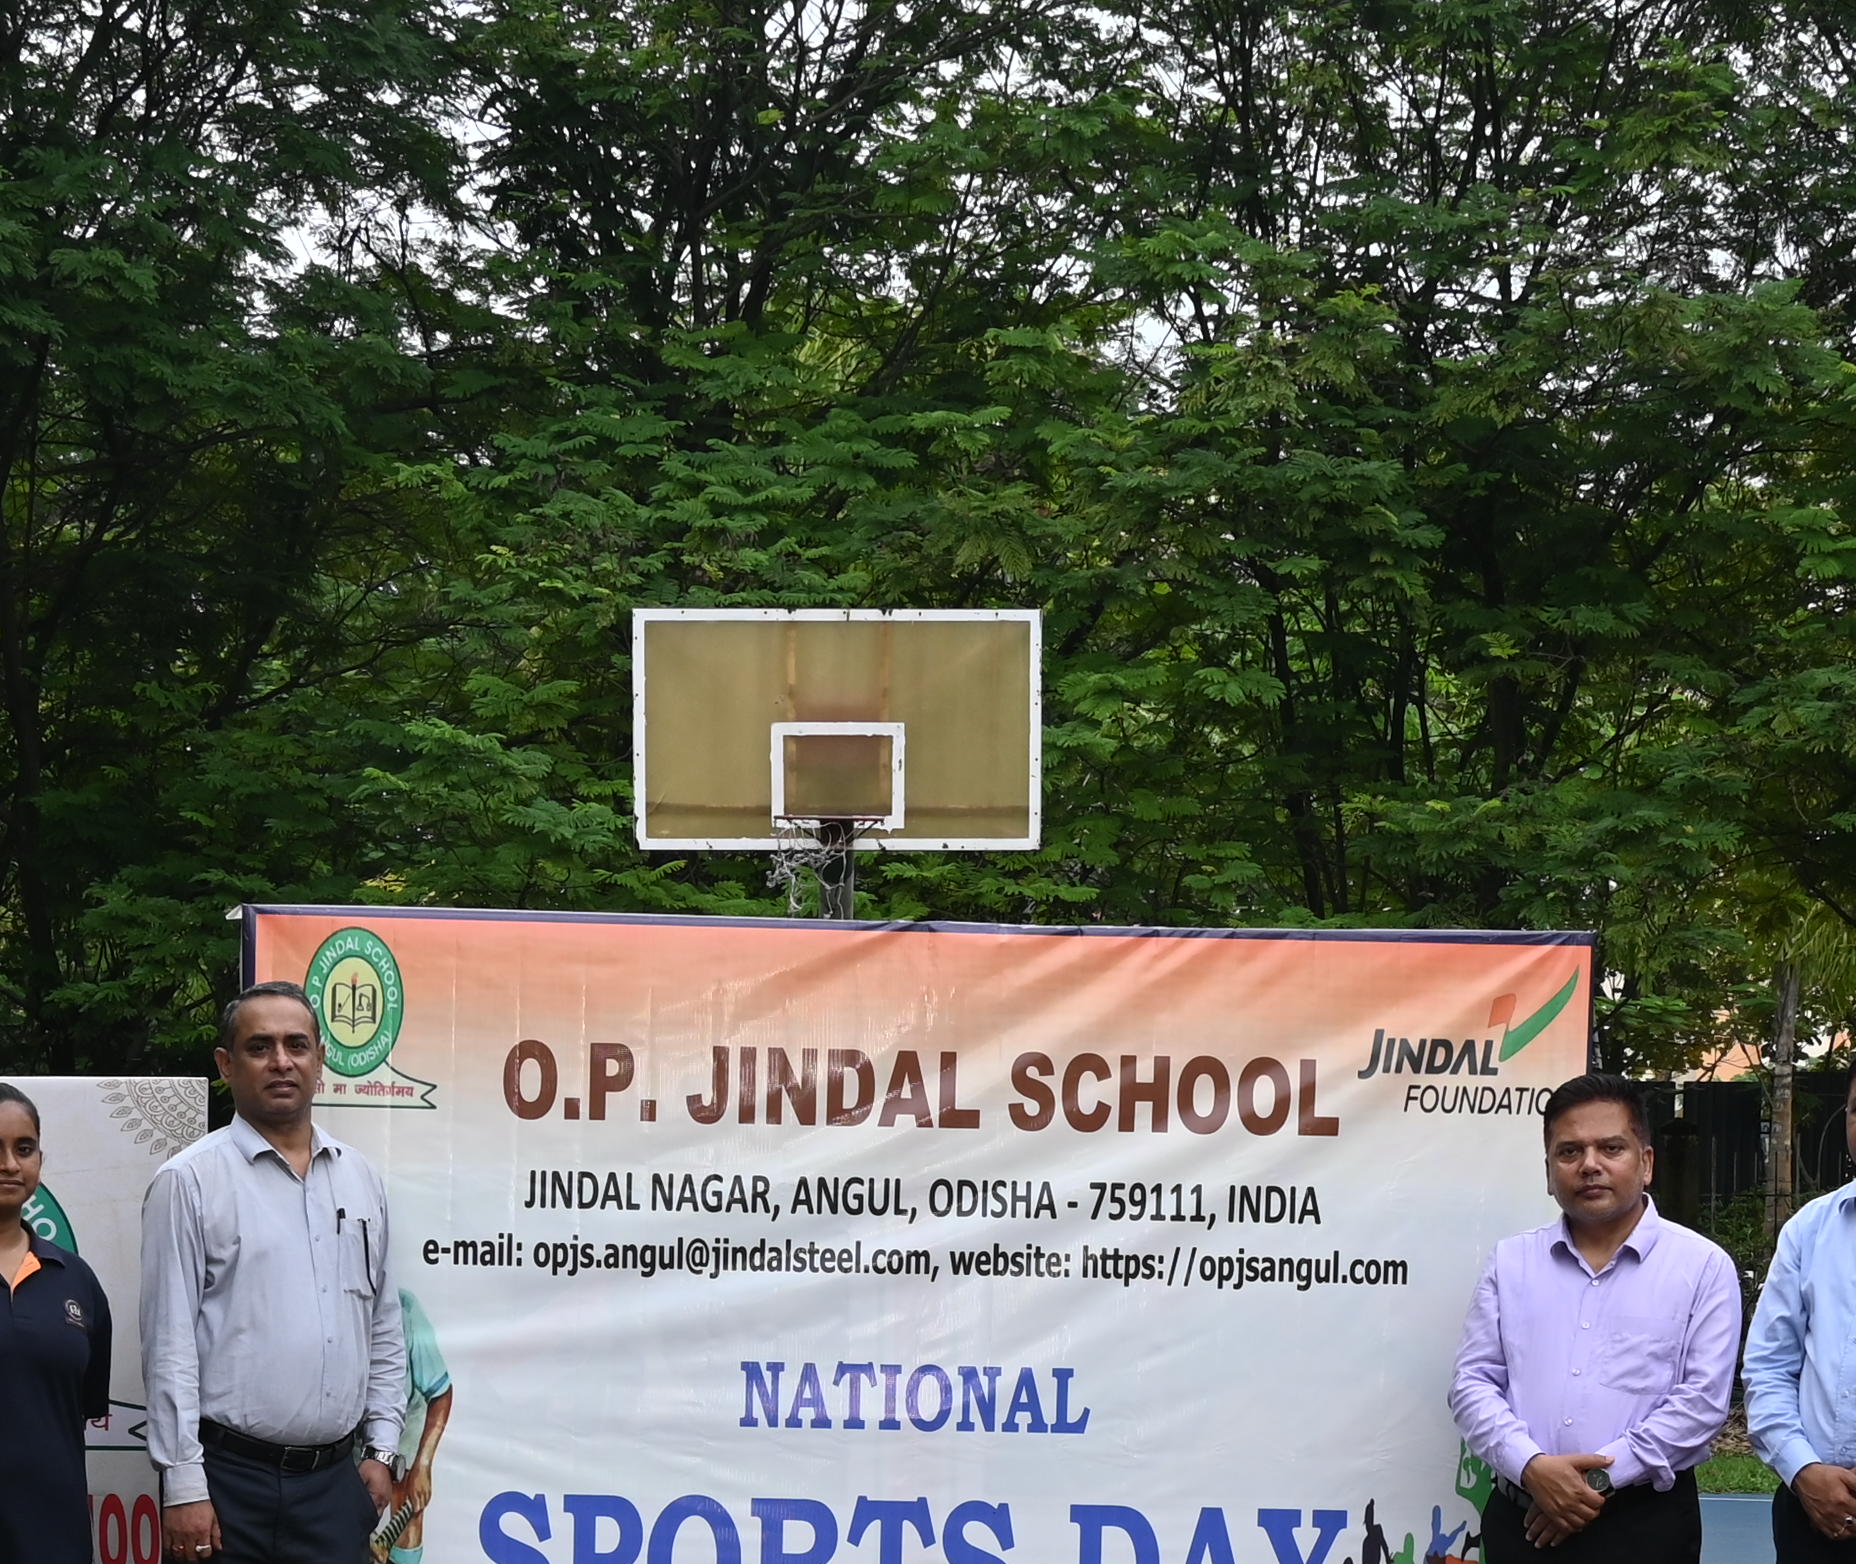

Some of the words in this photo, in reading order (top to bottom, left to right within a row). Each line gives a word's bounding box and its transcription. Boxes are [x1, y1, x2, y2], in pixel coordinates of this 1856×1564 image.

[311, 976, 322, 989] P
[318, 936, 360, 974] JINDAL
[365, 940, 398, 1010] SCHOOL
[309, 994, 320, 1009] O
[1357, 1028, 1499, 1080] JINDAL
[502, 1039, 657, 1122] O.P.
[685, 1045, 981, 1129] JINDAL
[1008, 1051, 1340, 1137] SCHOOL
[1403, 1084, 1554, 1116] FOUNDATIO
[523, 1169, 641, 1211] JINDAL
[651, 1173, 779, 1221] NAGAR,
[790, 1176, 918, 1224] ANGUL,
[930, 1178, 1057, 1220] ODISHA
[1089, 1182, 1217, 1231] 759111,
[1228, 1184, 1322, 1225] INDIA
[422, 1232, 525, 1267] e-mail:
[533, 1234, 939, 1281] opjs.angul@jindalsteel.com,
[949, 1242, 1072, 1279] website:
[1081, 1244, 1409, 1292] https://opjsangul.com
[739, 1360, 1091, 1435] NATIONAL
